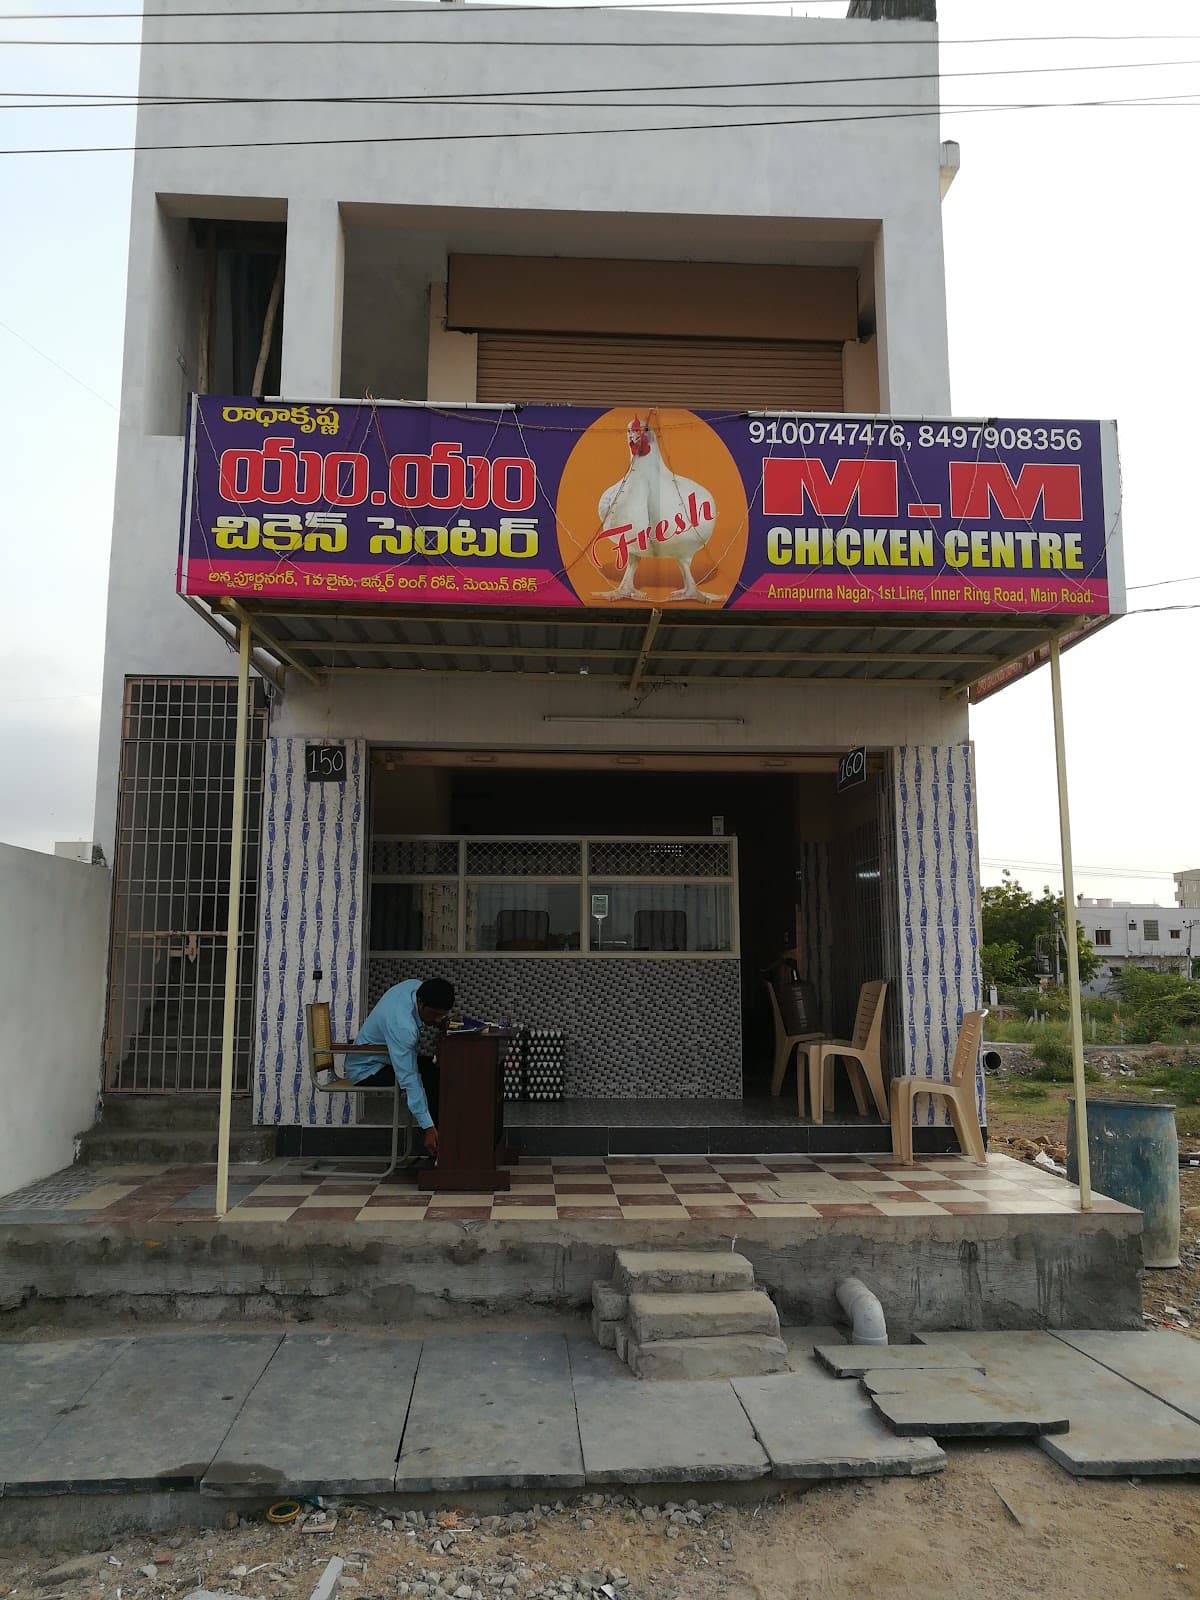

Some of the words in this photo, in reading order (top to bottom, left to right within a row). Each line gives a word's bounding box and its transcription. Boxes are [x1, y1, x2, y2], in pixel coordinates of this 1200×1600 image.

[748, 421, 912, 451] 9100747476,
[918, 426, 1083, 450] 8497908356
[211, 511, 348, 553] చికెన్
[366, 515, 539, 559] సెంటర్
[591, 492, 714, 571] Fresh
[766, 526, 934, 568] CHICKEN
[943, 528, 1085, 571] CENTRE
[768, 583, 833, 602] Annapurna
[837, 585, 874, 604] Nagar,
[878, 584, 895, 600] 1st
[899, 586, 927, 603] Line,
[931, 586, 960, 601] Inner
[964, 587, 991, 604] Ring
[994, 588, 1028, 604] Road,
[1031, 588, 1058, 603] Main
[309, 748, 344, 775] 150
[840, 751, 863, 784] 160
